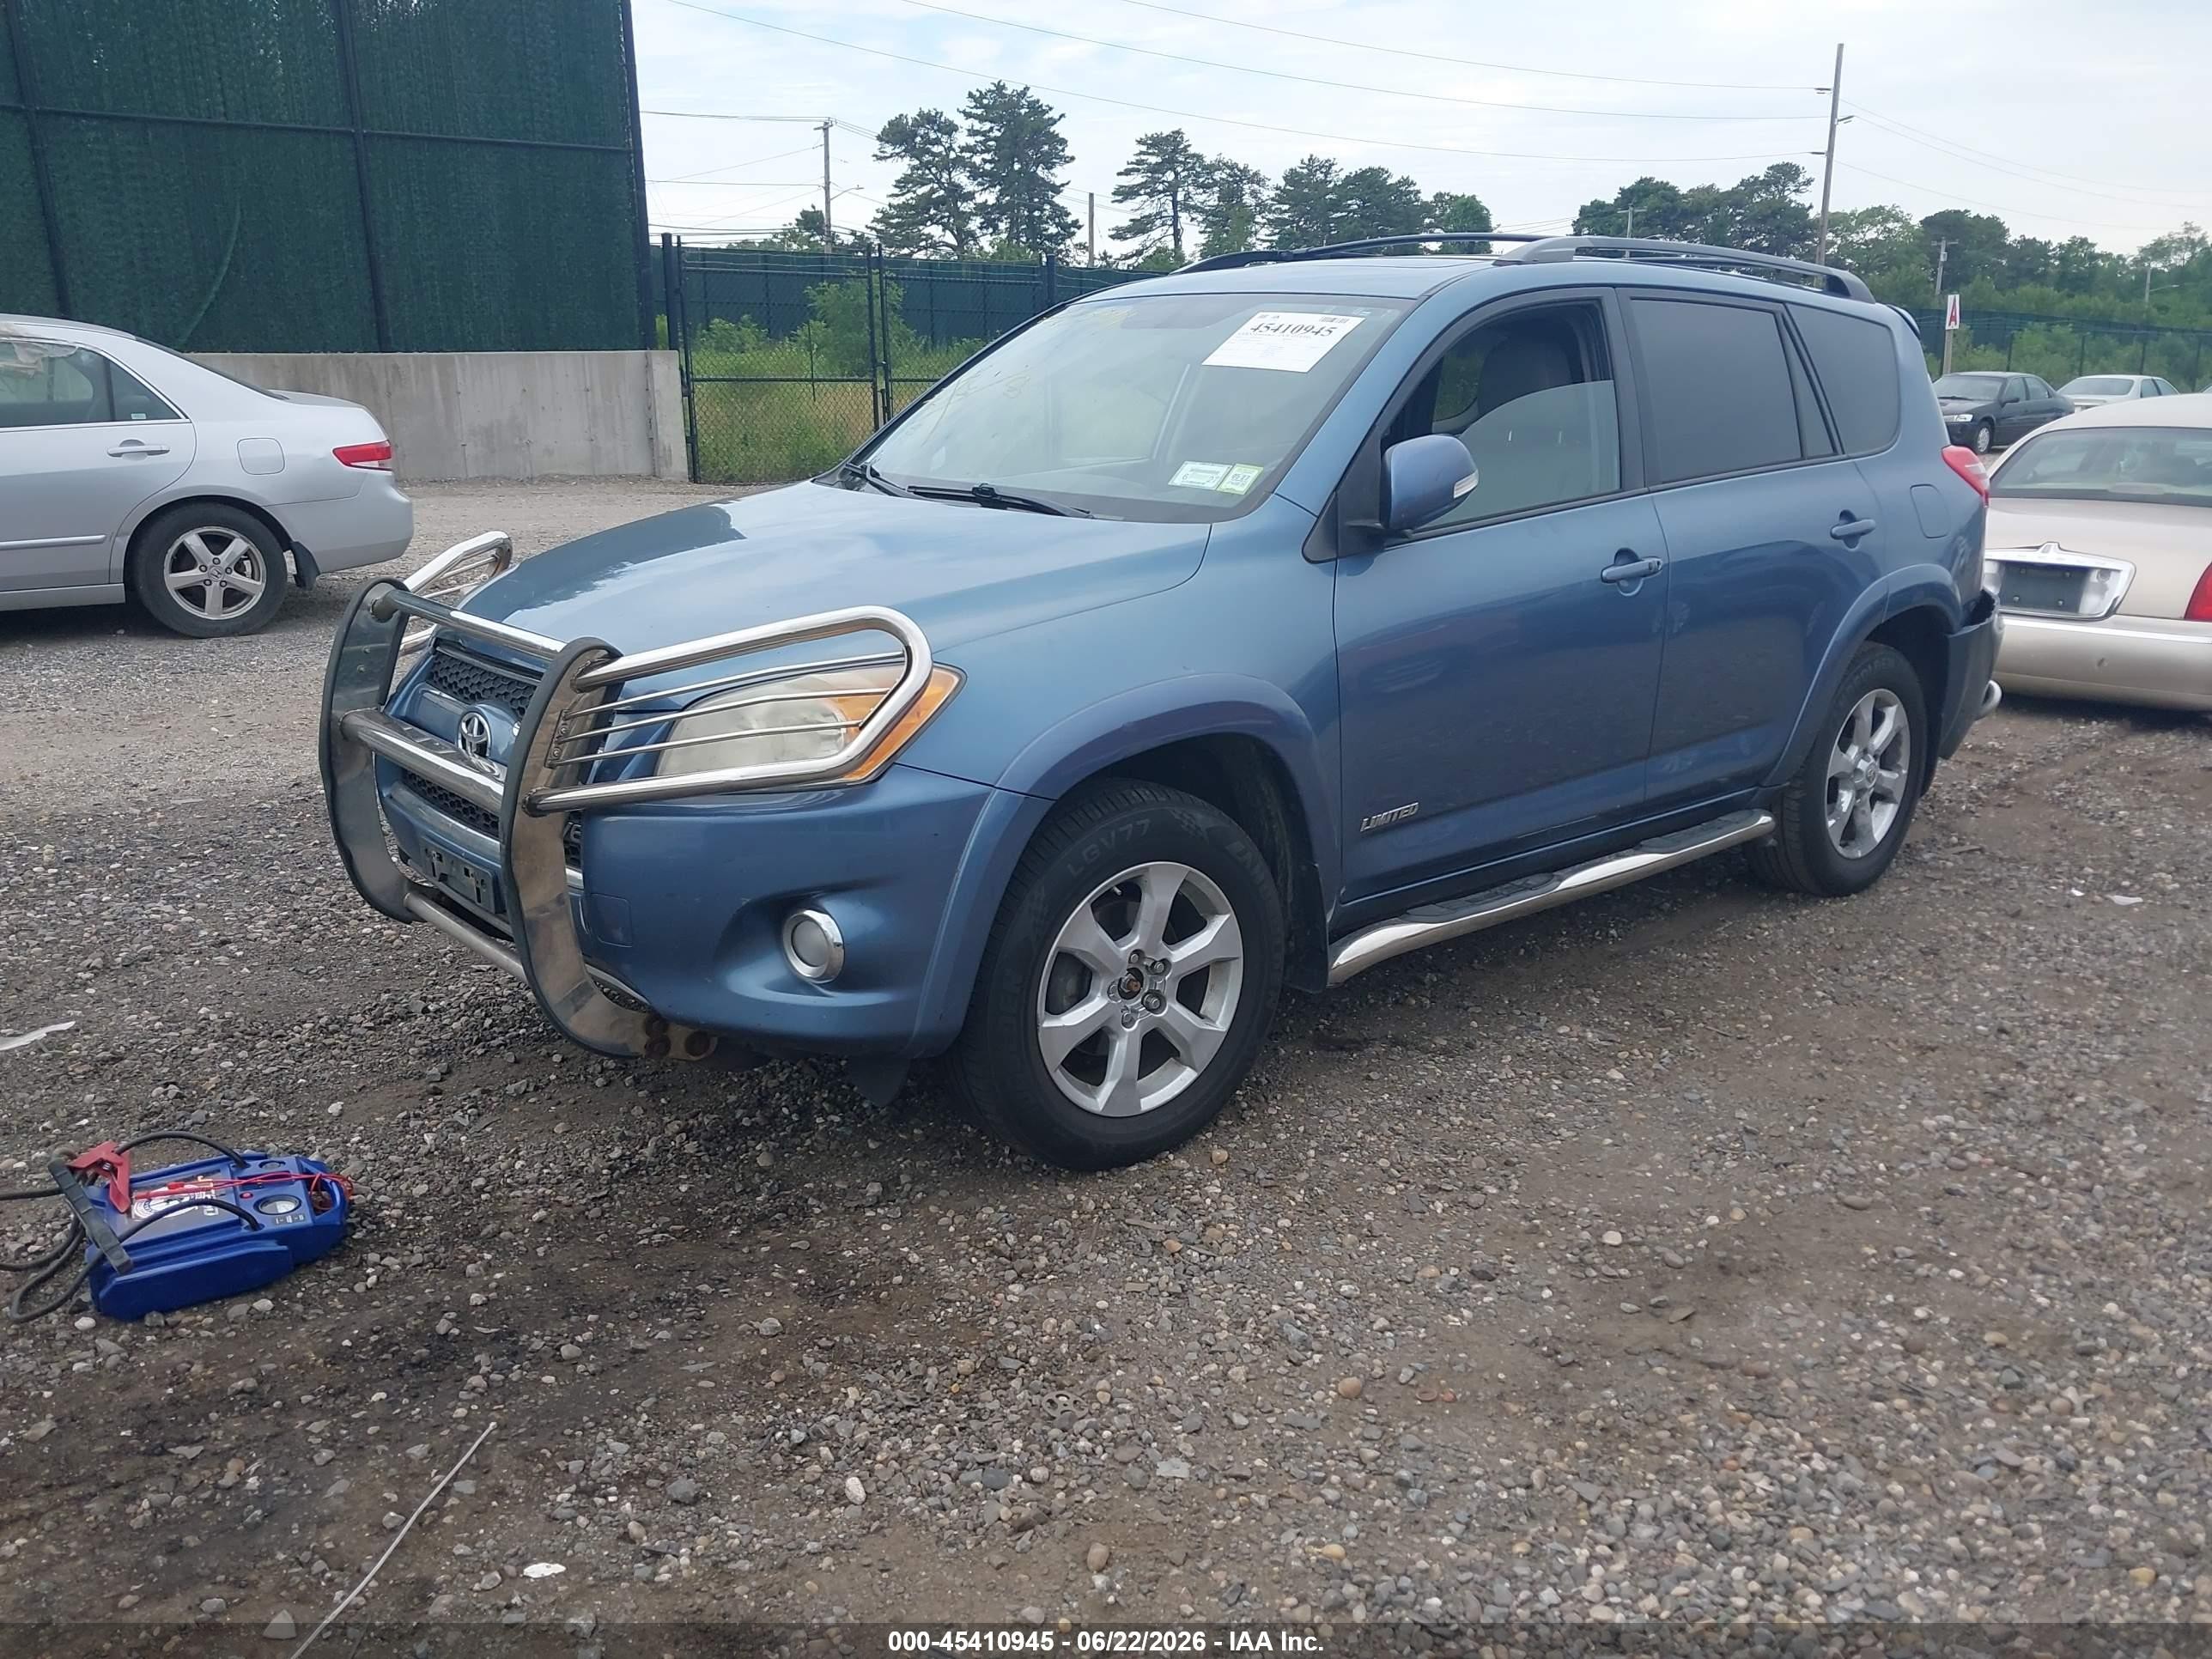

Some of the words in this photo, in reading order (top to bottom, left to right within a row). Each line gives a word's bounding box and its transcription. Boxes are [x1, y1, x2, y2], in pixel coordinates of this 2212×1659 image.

[1948, 295, 1957, 325] A
[1250, 323, 1338, 337] 45410945
[1360, 802, 1419, 832] LIMITED
[1067, 817, 1152, 877] LGV77
